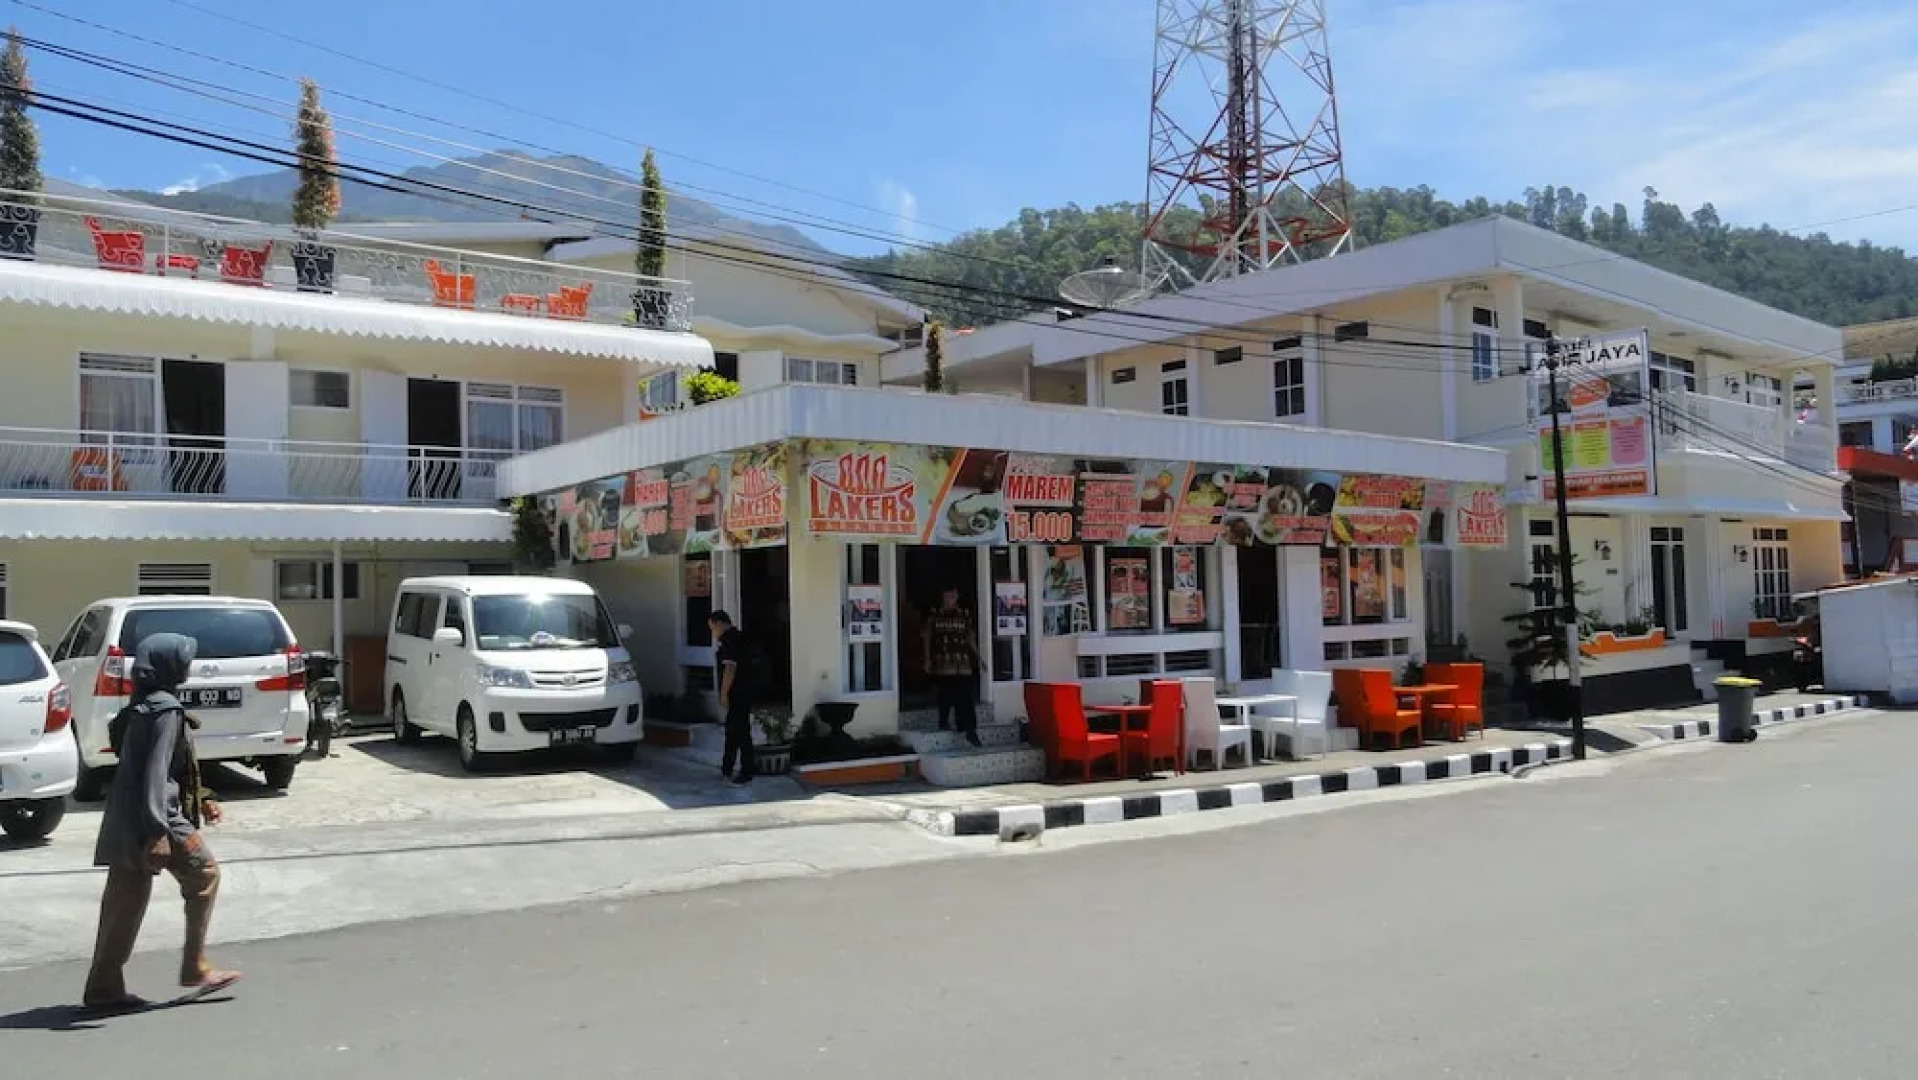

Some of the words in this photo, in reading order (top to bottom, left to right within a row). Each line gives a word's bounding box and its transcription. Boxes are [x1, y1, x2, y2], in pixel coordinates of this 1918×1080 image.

[1586, 344, 1641, 363] JAYA
[731, 486, 782, 519] LAKERS
[809, 476, 917, 523] LAKERS
[1006, 475, 1074, 500] MAREM
[1008, 512, 1073, 543] 15.000
[1457, 507, 1505, 536] LAKERS
